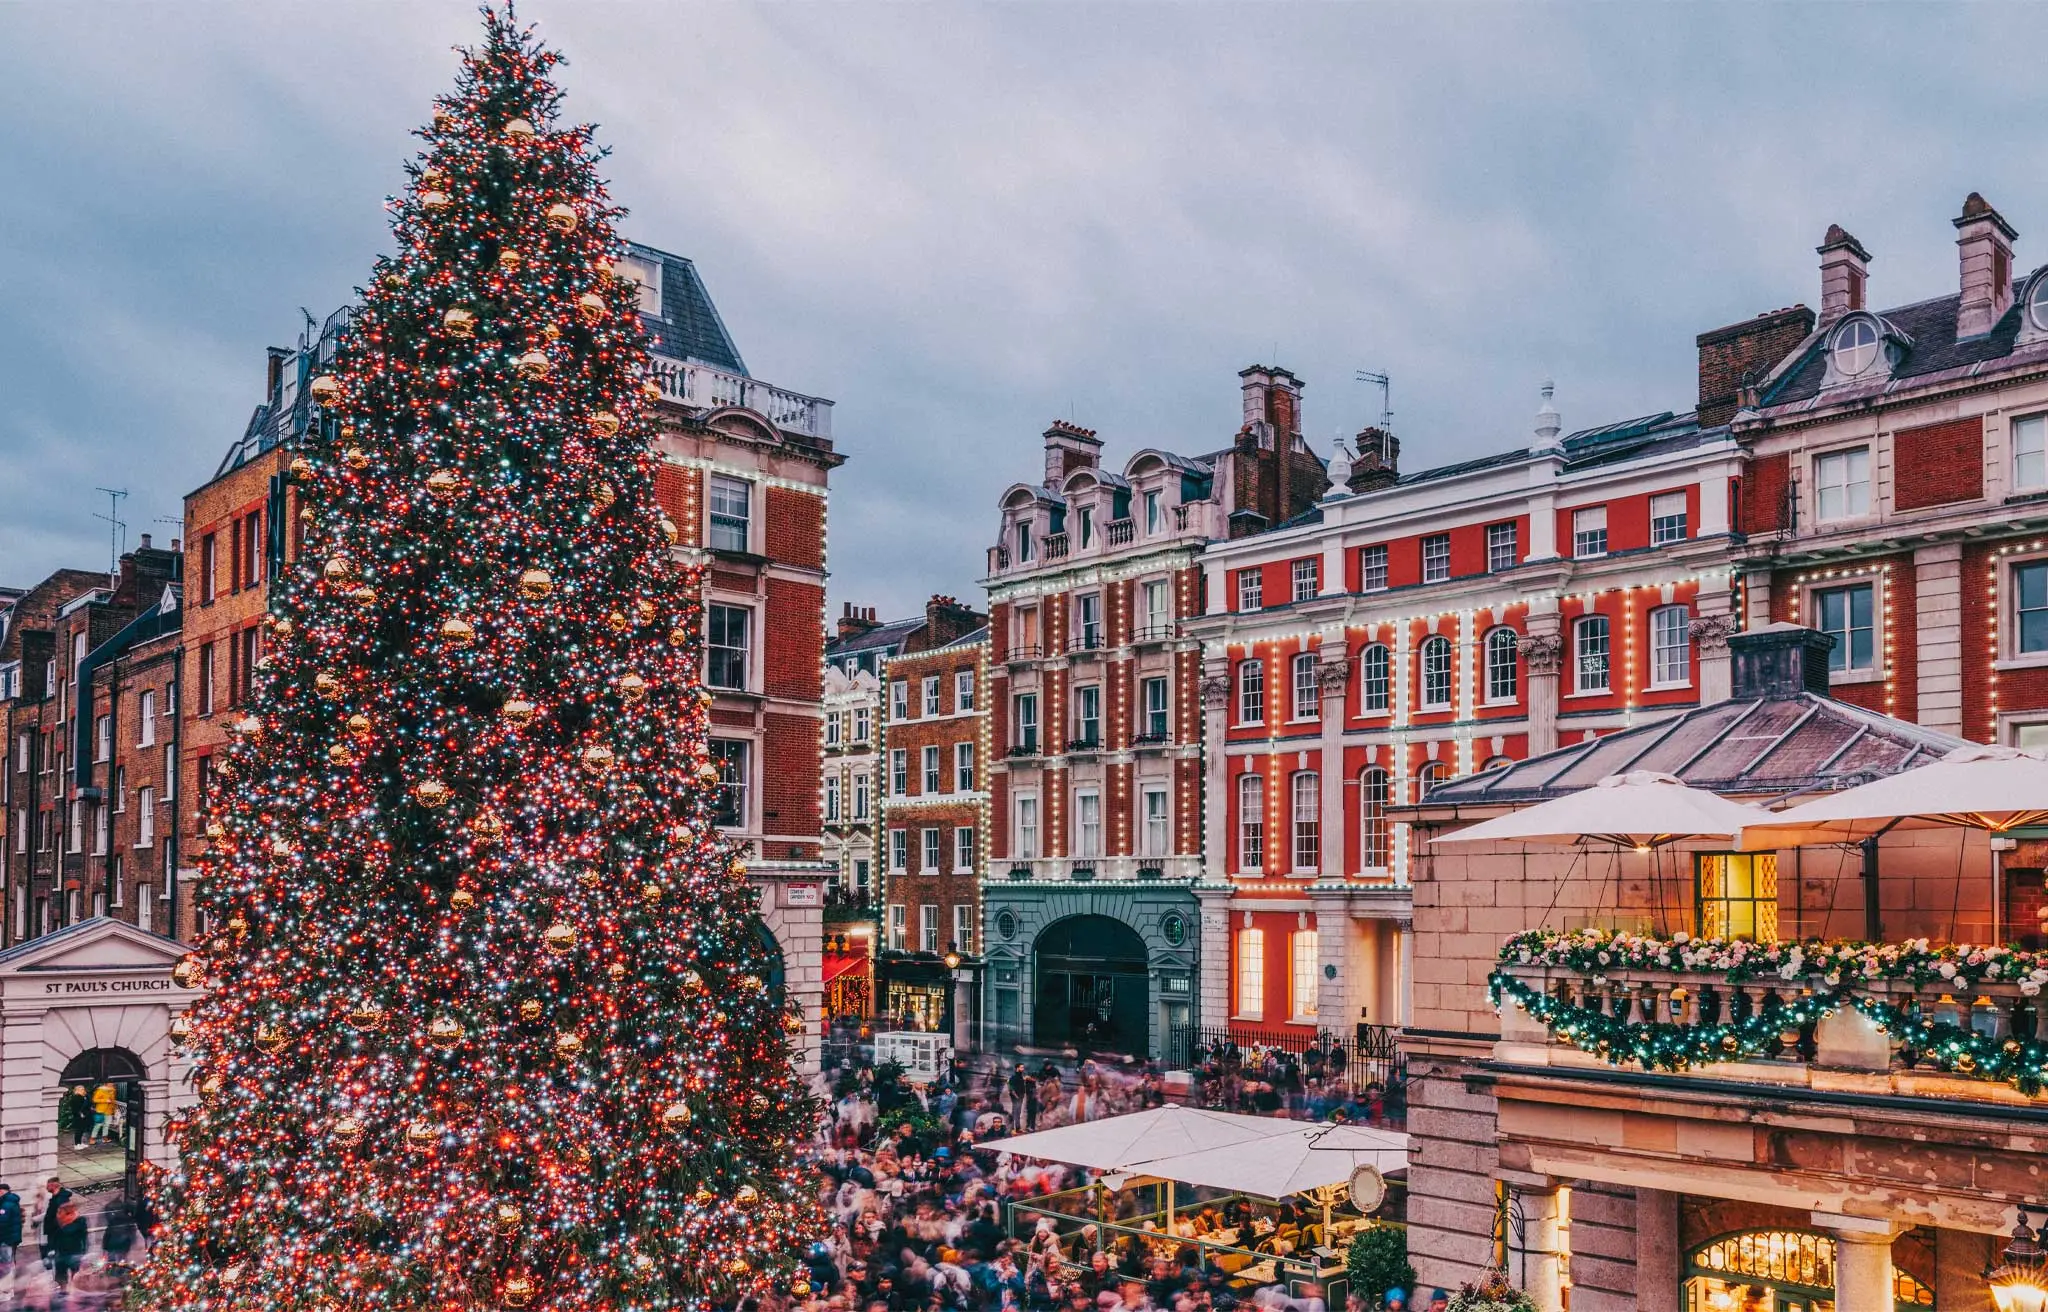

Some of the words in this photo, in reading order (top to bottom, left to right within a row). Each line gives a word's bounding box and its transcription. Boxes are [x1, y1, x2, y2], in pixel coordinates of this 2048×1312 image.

[46, 983, 62, 993] ST
[66, 981, 108, 993] PAUL'S
[111, 980, 170, 992] CHURCH
